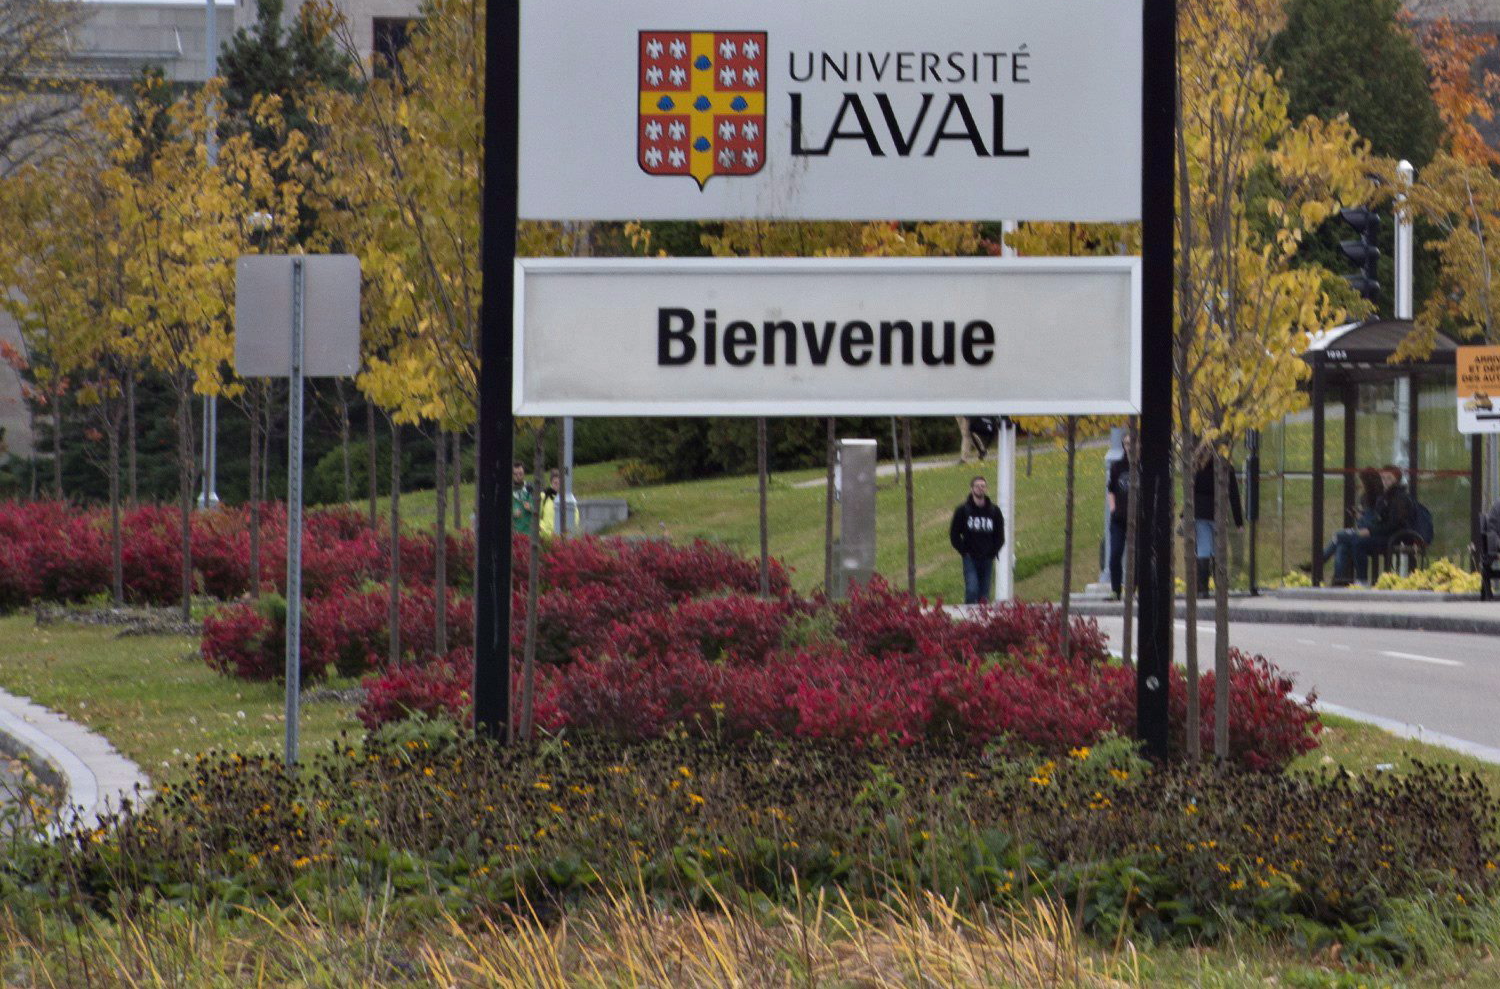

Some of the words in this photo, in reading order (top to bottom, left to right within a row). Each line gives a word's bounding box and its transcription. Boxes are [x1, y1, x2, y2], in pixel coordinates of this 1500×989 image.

[788, 42, 1031, 84] UNIVERSITÉ
[788, 92, 1030, 158] LAVAL
[656, 306, 996, 367] Bienvenue
[1461, 374, 1480, 383] DES
[1468, 365, 1480, 373] ET
